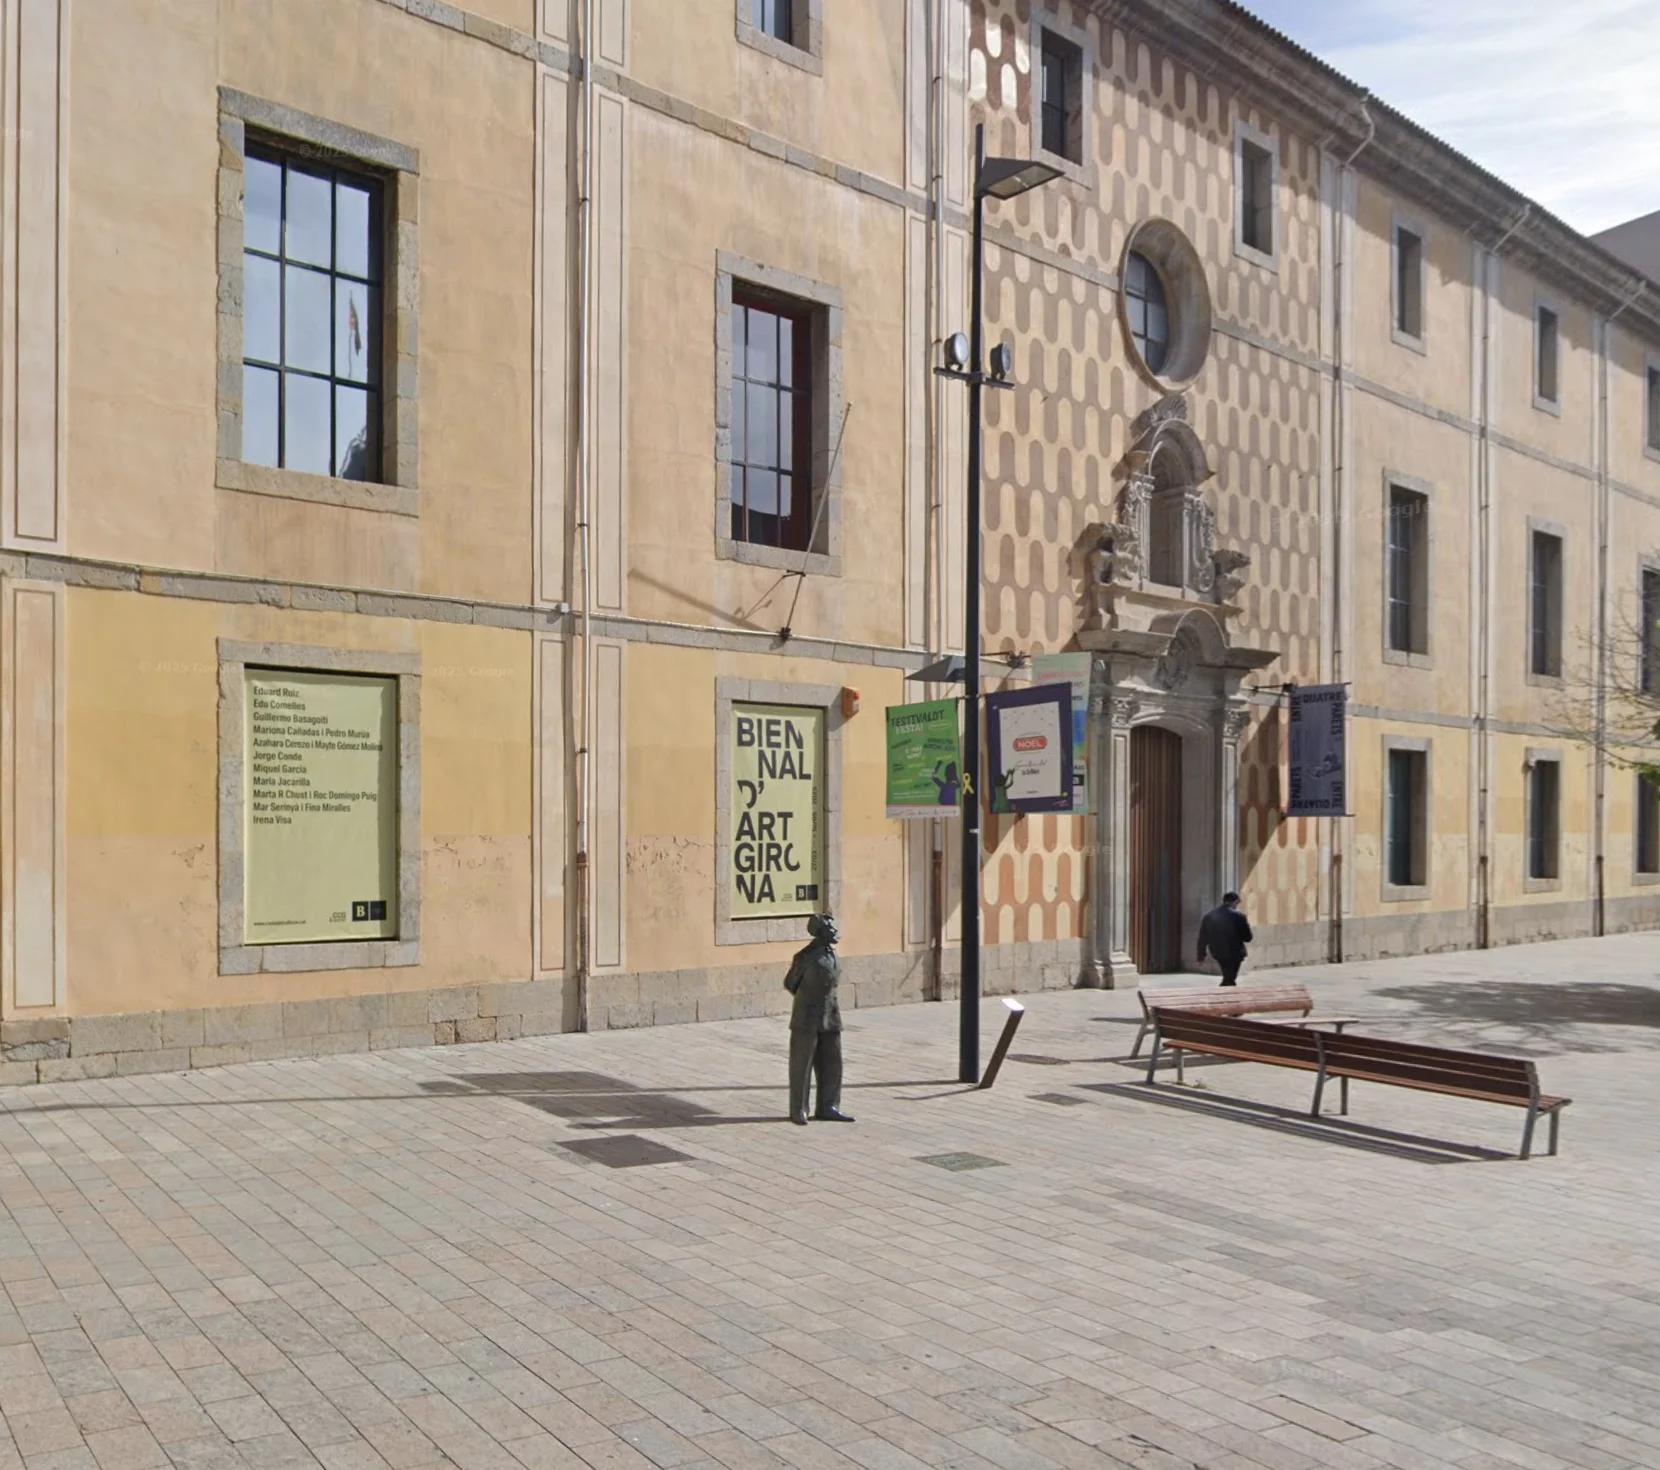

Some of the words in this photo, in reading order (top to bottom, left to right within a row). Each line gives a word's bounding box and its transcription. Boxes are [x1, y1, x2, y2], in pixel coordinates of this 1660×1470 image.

[253, 686, 281, 696] Eduard
[282, 688, 300, 698] Ruiz
[1303, 691, 1343, 704] QUATRE
[253, 698, 269, 709] Edu
[253, 712, 292, 723] Guillermo
[293, 714, 329, 725] Basagoiti
[253, 725, 286, 735] Mariona
[325, 728, 347, 738] Pedro
[737, 717, 804, 749] BIEN
[253, 738, 285, 748] Azahara
[285, 739, 311, 749] Cerezo
[315, 740, 336, 751] Mayte
[361, 741, 383, 752] Molina
[1017, 738, 1042, 749] NOEL
[253, 751, 276, 761] Jorge
[278, 752, 303, 761] Conde
[253, 764, 281, 775] Miquel
[757, 749, 811, 780] NAL
[253, 789, 277, 798] Marta
[278, 790, 284, 798] R
[285, 790, 308, 799] Chust
[313, 790, 327, 799] Roc
[328, 791, 360, 801] Domingo
[361, 791, 377, 802] Puig
[253, 802, 269, 811] Mar
[305, 803, 321, 812] Fina
[322, 803, 351, 813] Miralles
[253, 816, 274, 824] Irena
[275, 816, 292, 824] Visa
[735, 811, 793, 841] ART
[736, 874, 776, 903] NA
[356, 905, 365, 917] B
